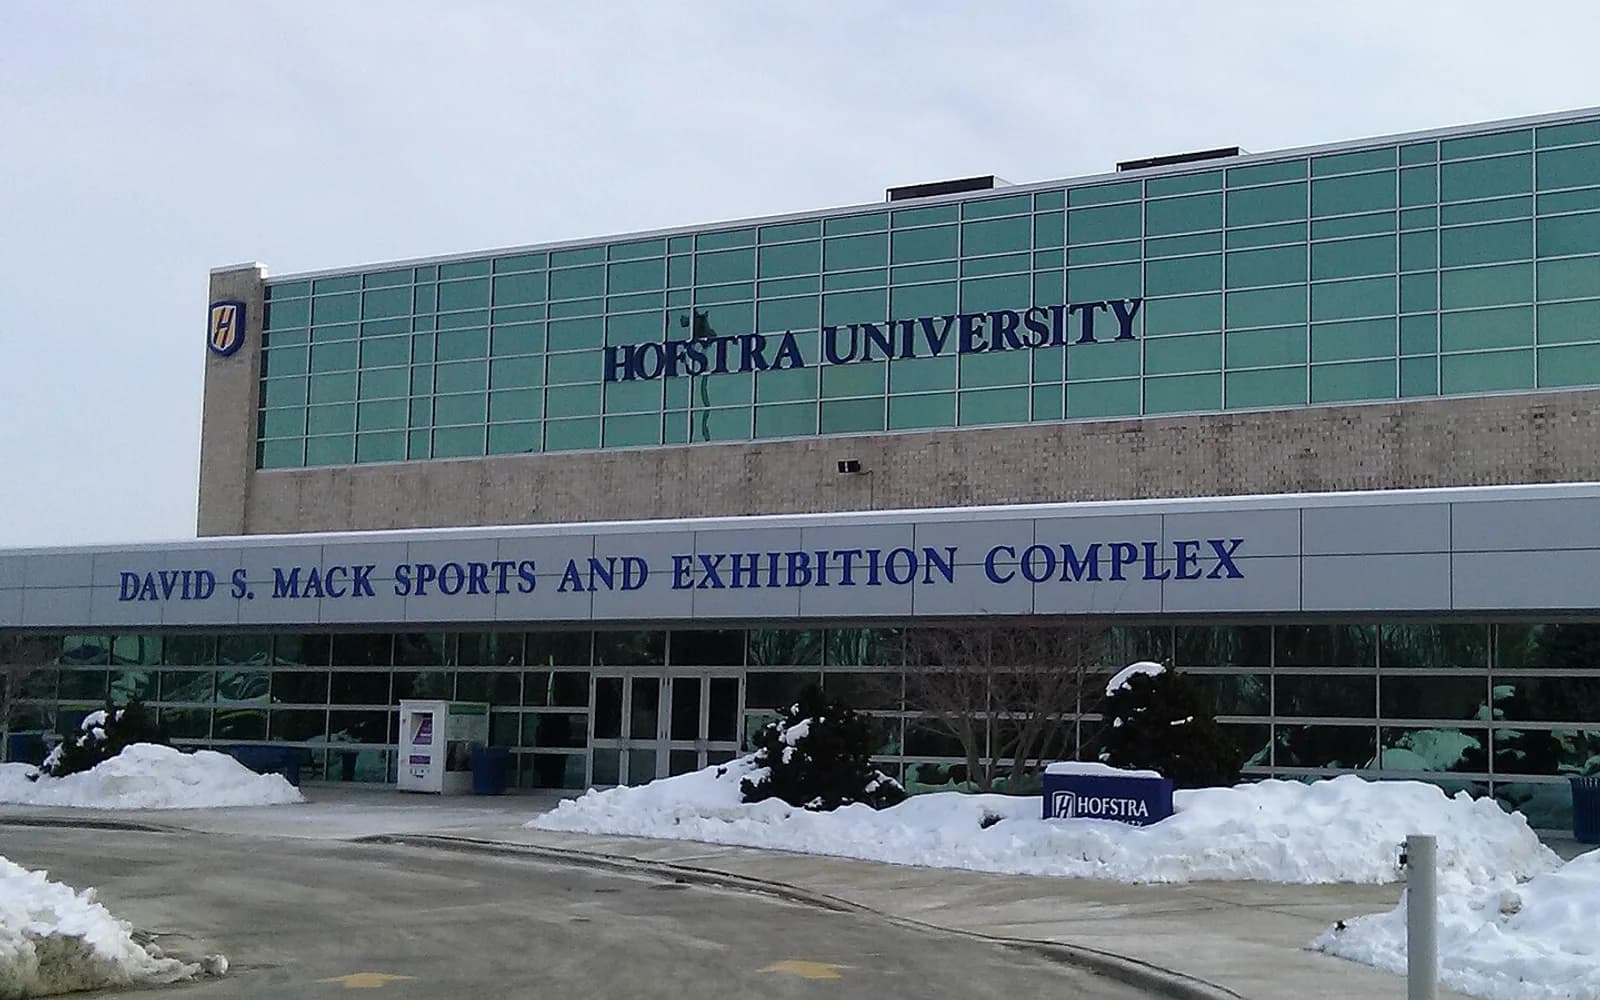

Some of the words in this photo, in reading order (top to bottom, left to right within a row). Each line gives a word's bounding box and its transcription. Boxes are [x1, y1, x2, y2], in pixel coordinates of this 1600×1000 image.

[605, 331, 804, 382] HOFSTRA
[823, 298, 1142, 365] UNIVERSITY
[119, 570, 215, 601] DAVID
[231, 568, 254, 599] S.
[272, 565, 375, 598] MACK
[395, 560, 536, 596] SPORTS
[557, 556, 648, 592] AND
[671, 546, 957, 590] EXHIBITION
[984, 539, 1244, 584] COMPLEX
[1078, 796, 1148, 817] HOFSTRA
